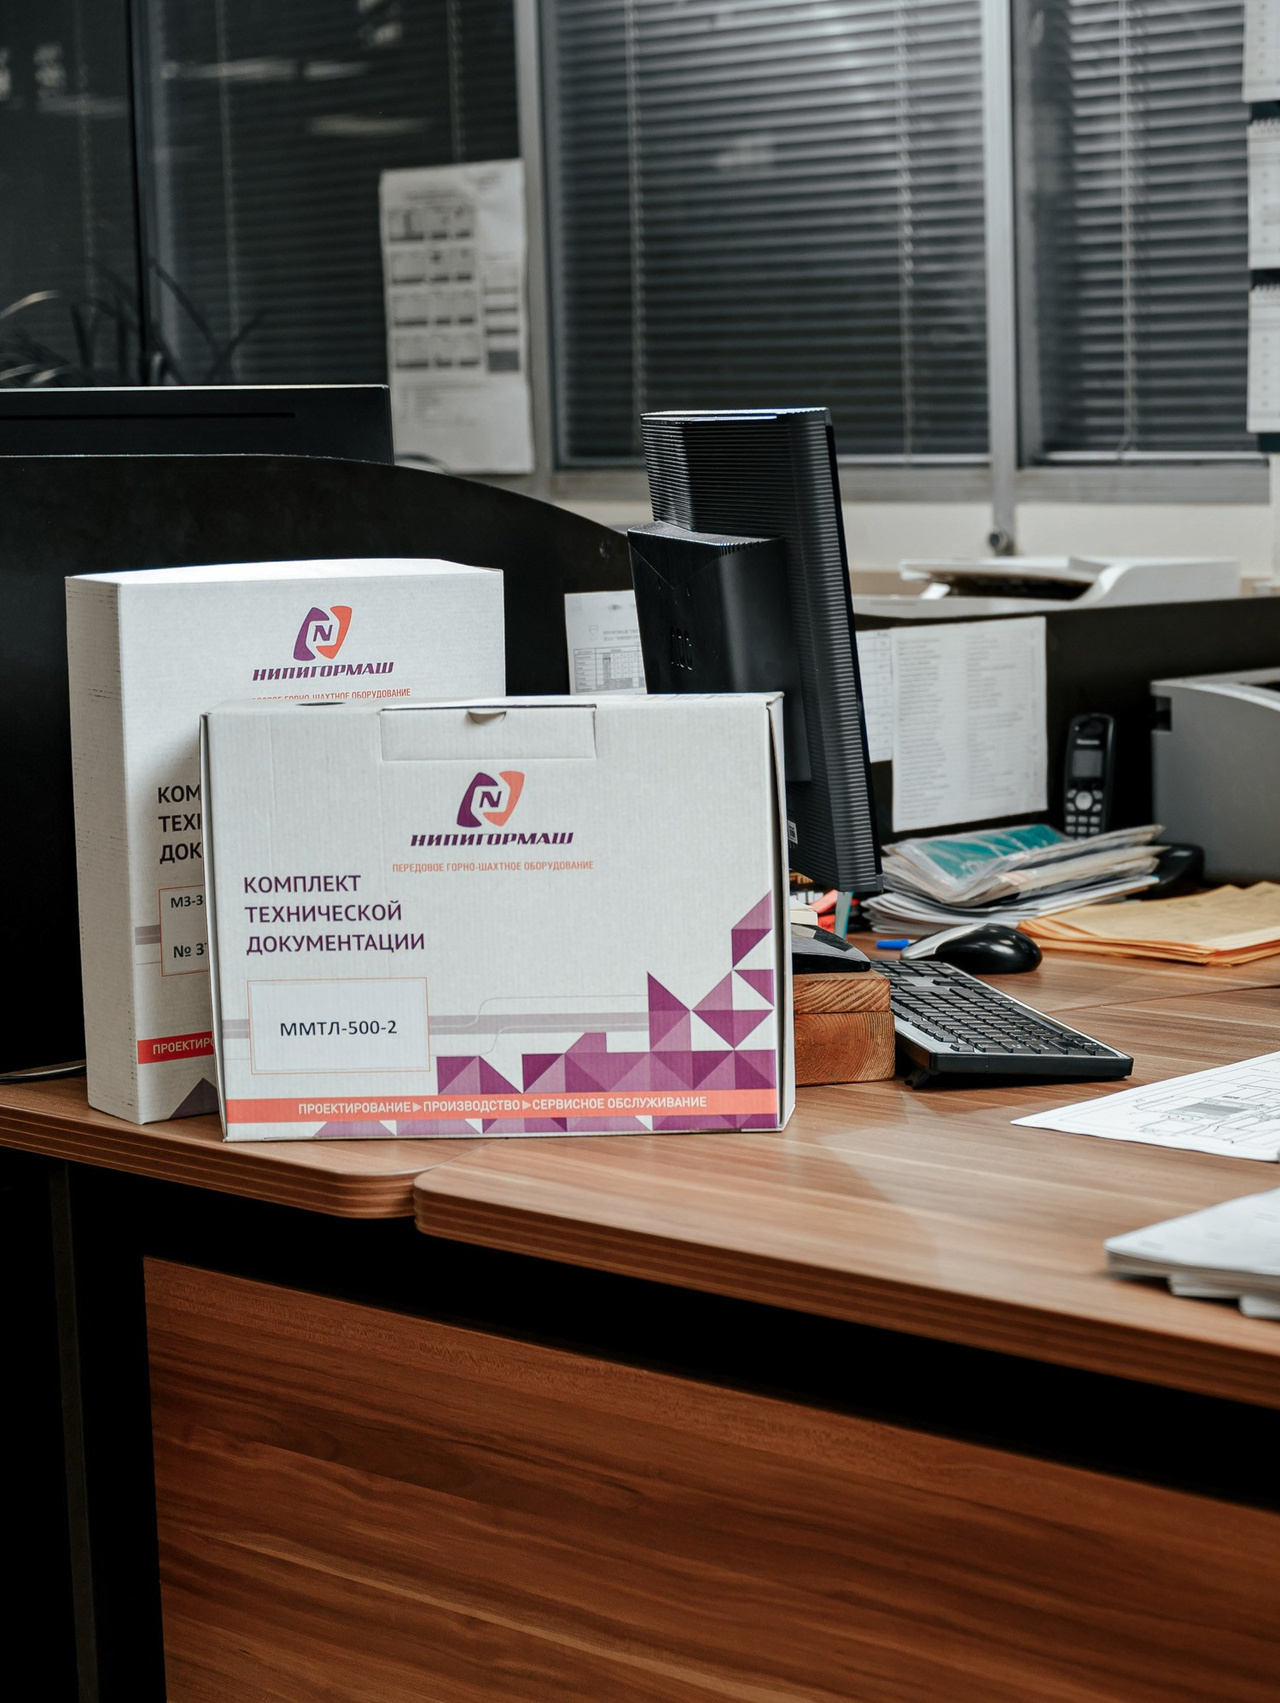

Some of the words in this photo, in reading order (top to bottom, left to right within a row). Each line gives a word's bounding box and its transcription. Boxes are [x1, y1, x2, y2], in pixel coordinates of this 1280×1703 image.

[252, 662, 394, 681] НИПИГОРМАШ
[352, 688, 410, 698] ОБОРУДОВАНИЕ
[410, 832, 574, 847] НИПИГОРМАШ
[392, 863, 444, 874] ПЕРЕДОВОЕ
[446, 862, 521, 872] ГОРНО-ШАХТНОЕ
[524, 860, 594, 872] ОБОРУДОВАНИЕ
[244, 874, 361, 894] КОМПЛЕКТ
[244, 900, 402, 923] ТЕХНИЧЕСКОЙ
[196, 942, 208, 956] 3
[246, 934, 425, 956] ДОКУМЕНТАЦИИ
[280, 1020, 398, 1036] ММТЛ-500-2
[298, 1102, 411, 1114] ПРОЕКТИРОВАНИЕ
[424, 1100, 520, 1113] ПРОИЗВОДСТВО
[532, 1098, 604, 1110] СЕРВИСНОЕ
[608, 1096, 707, 1109] ОБСЛУЖИВАНИЕ
